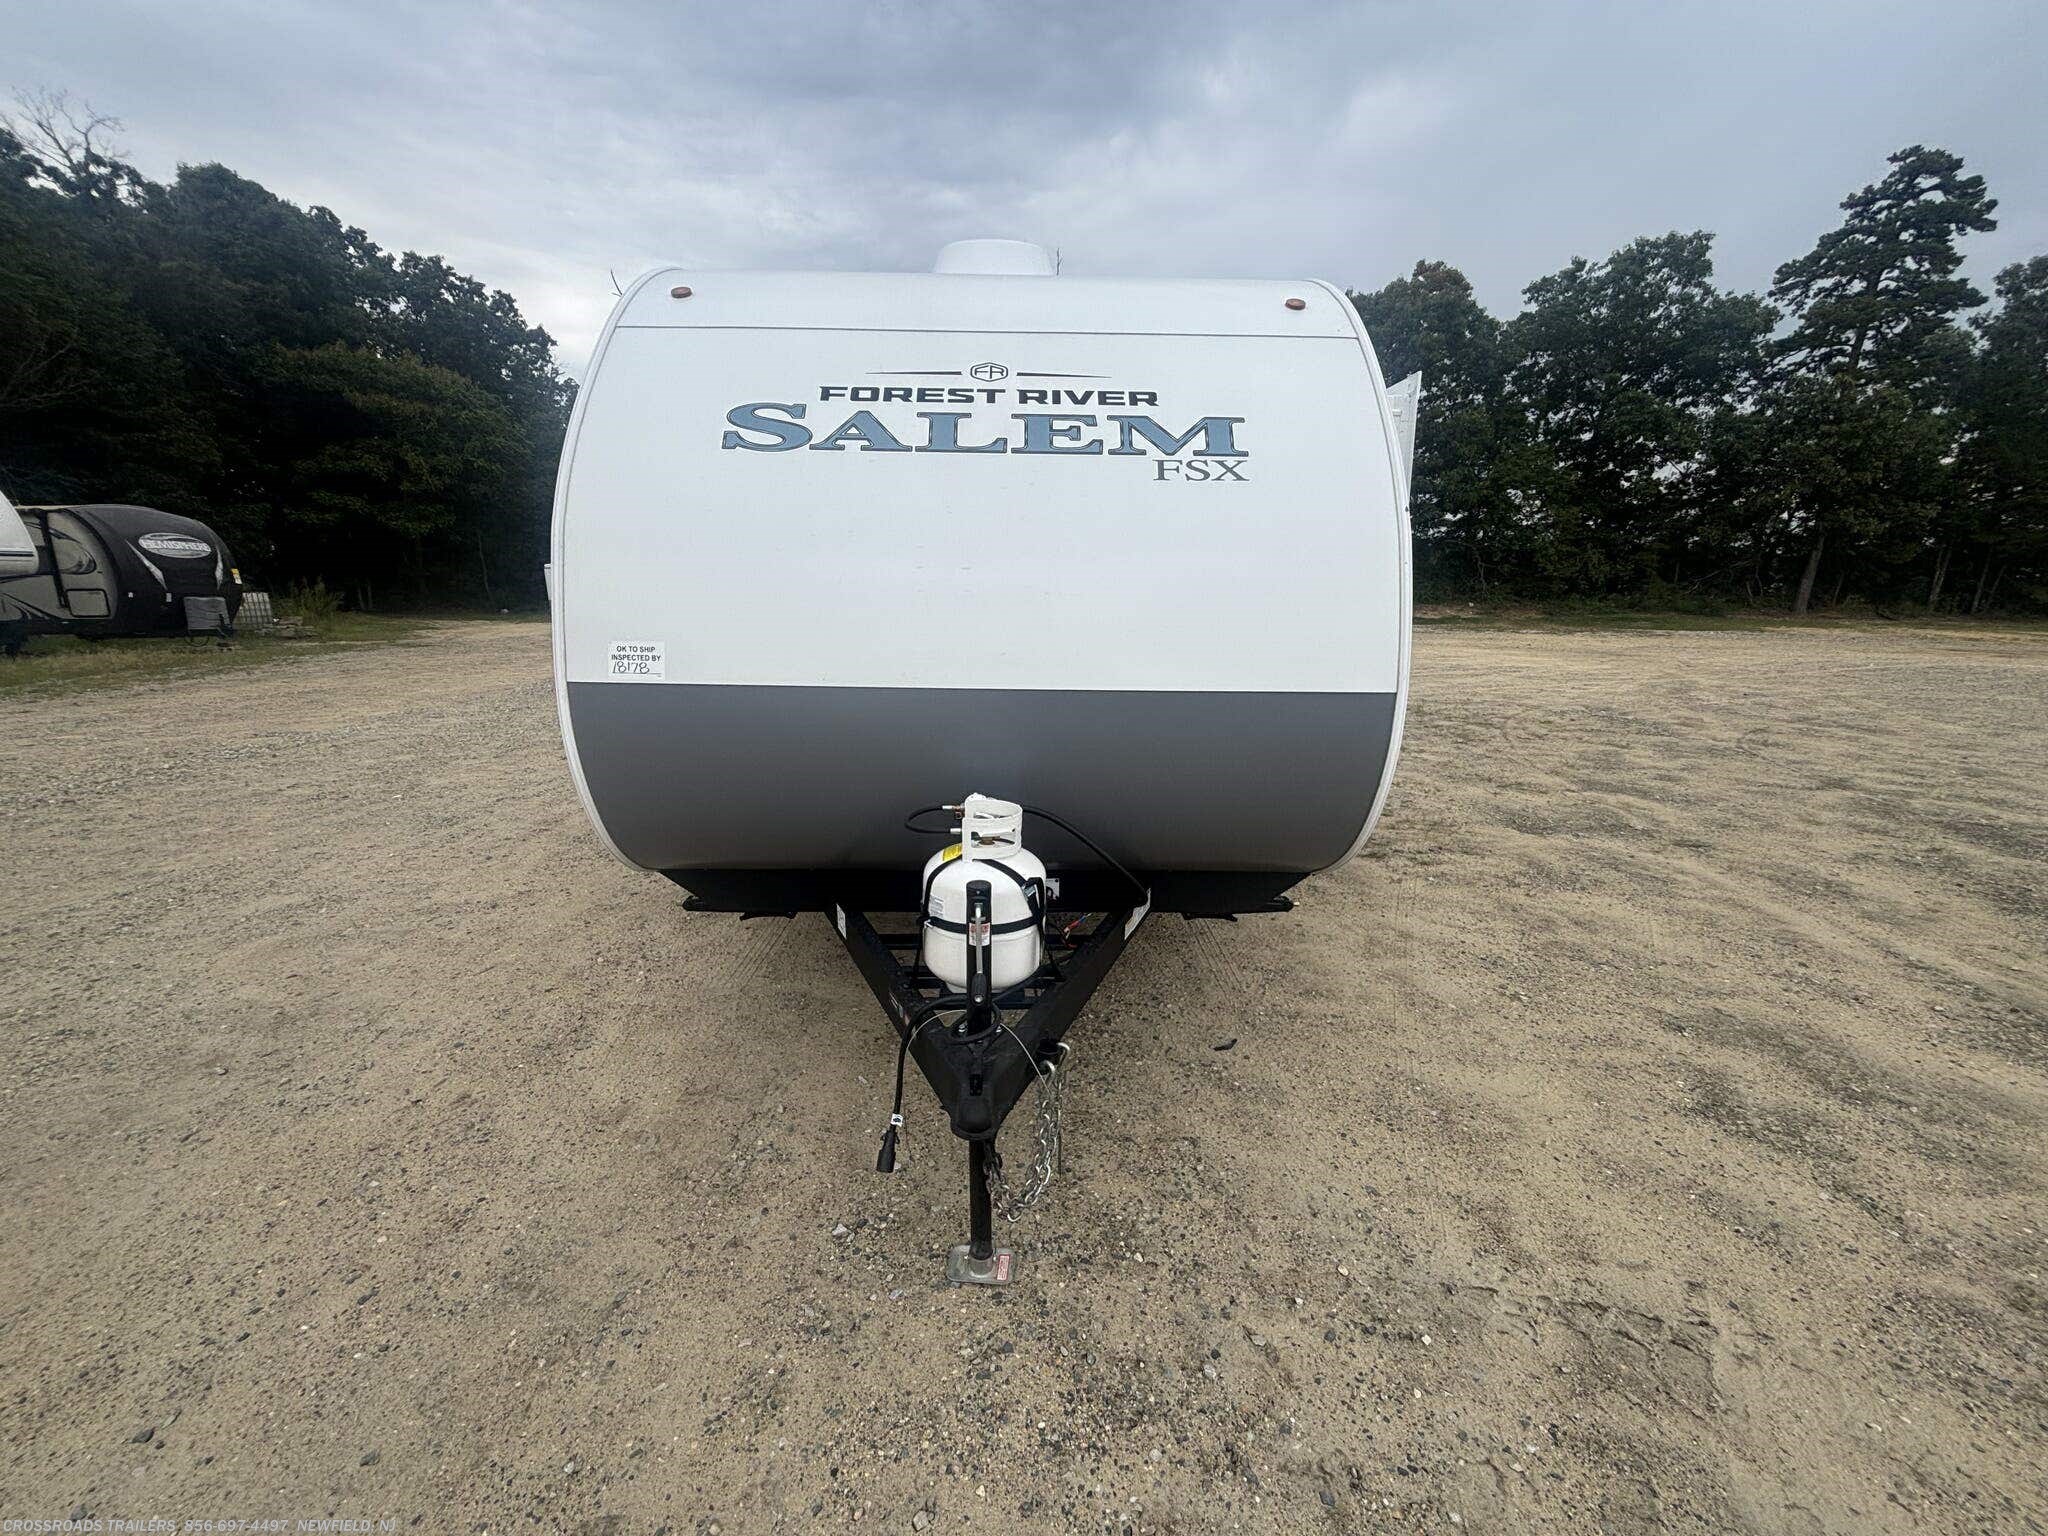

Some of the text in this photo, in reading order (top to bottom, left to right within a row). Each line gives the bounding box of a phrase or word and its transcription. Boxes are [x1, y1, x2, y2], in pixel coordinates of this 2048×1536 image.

[818, 385, 1160, 407] FOREST RIVER
[721, 402, 1250, 457] SALEM
[1152, 459, 1250, 482] FSX
[616, 645, 627, 653] OK
[628, 645, 638, 653] TO
